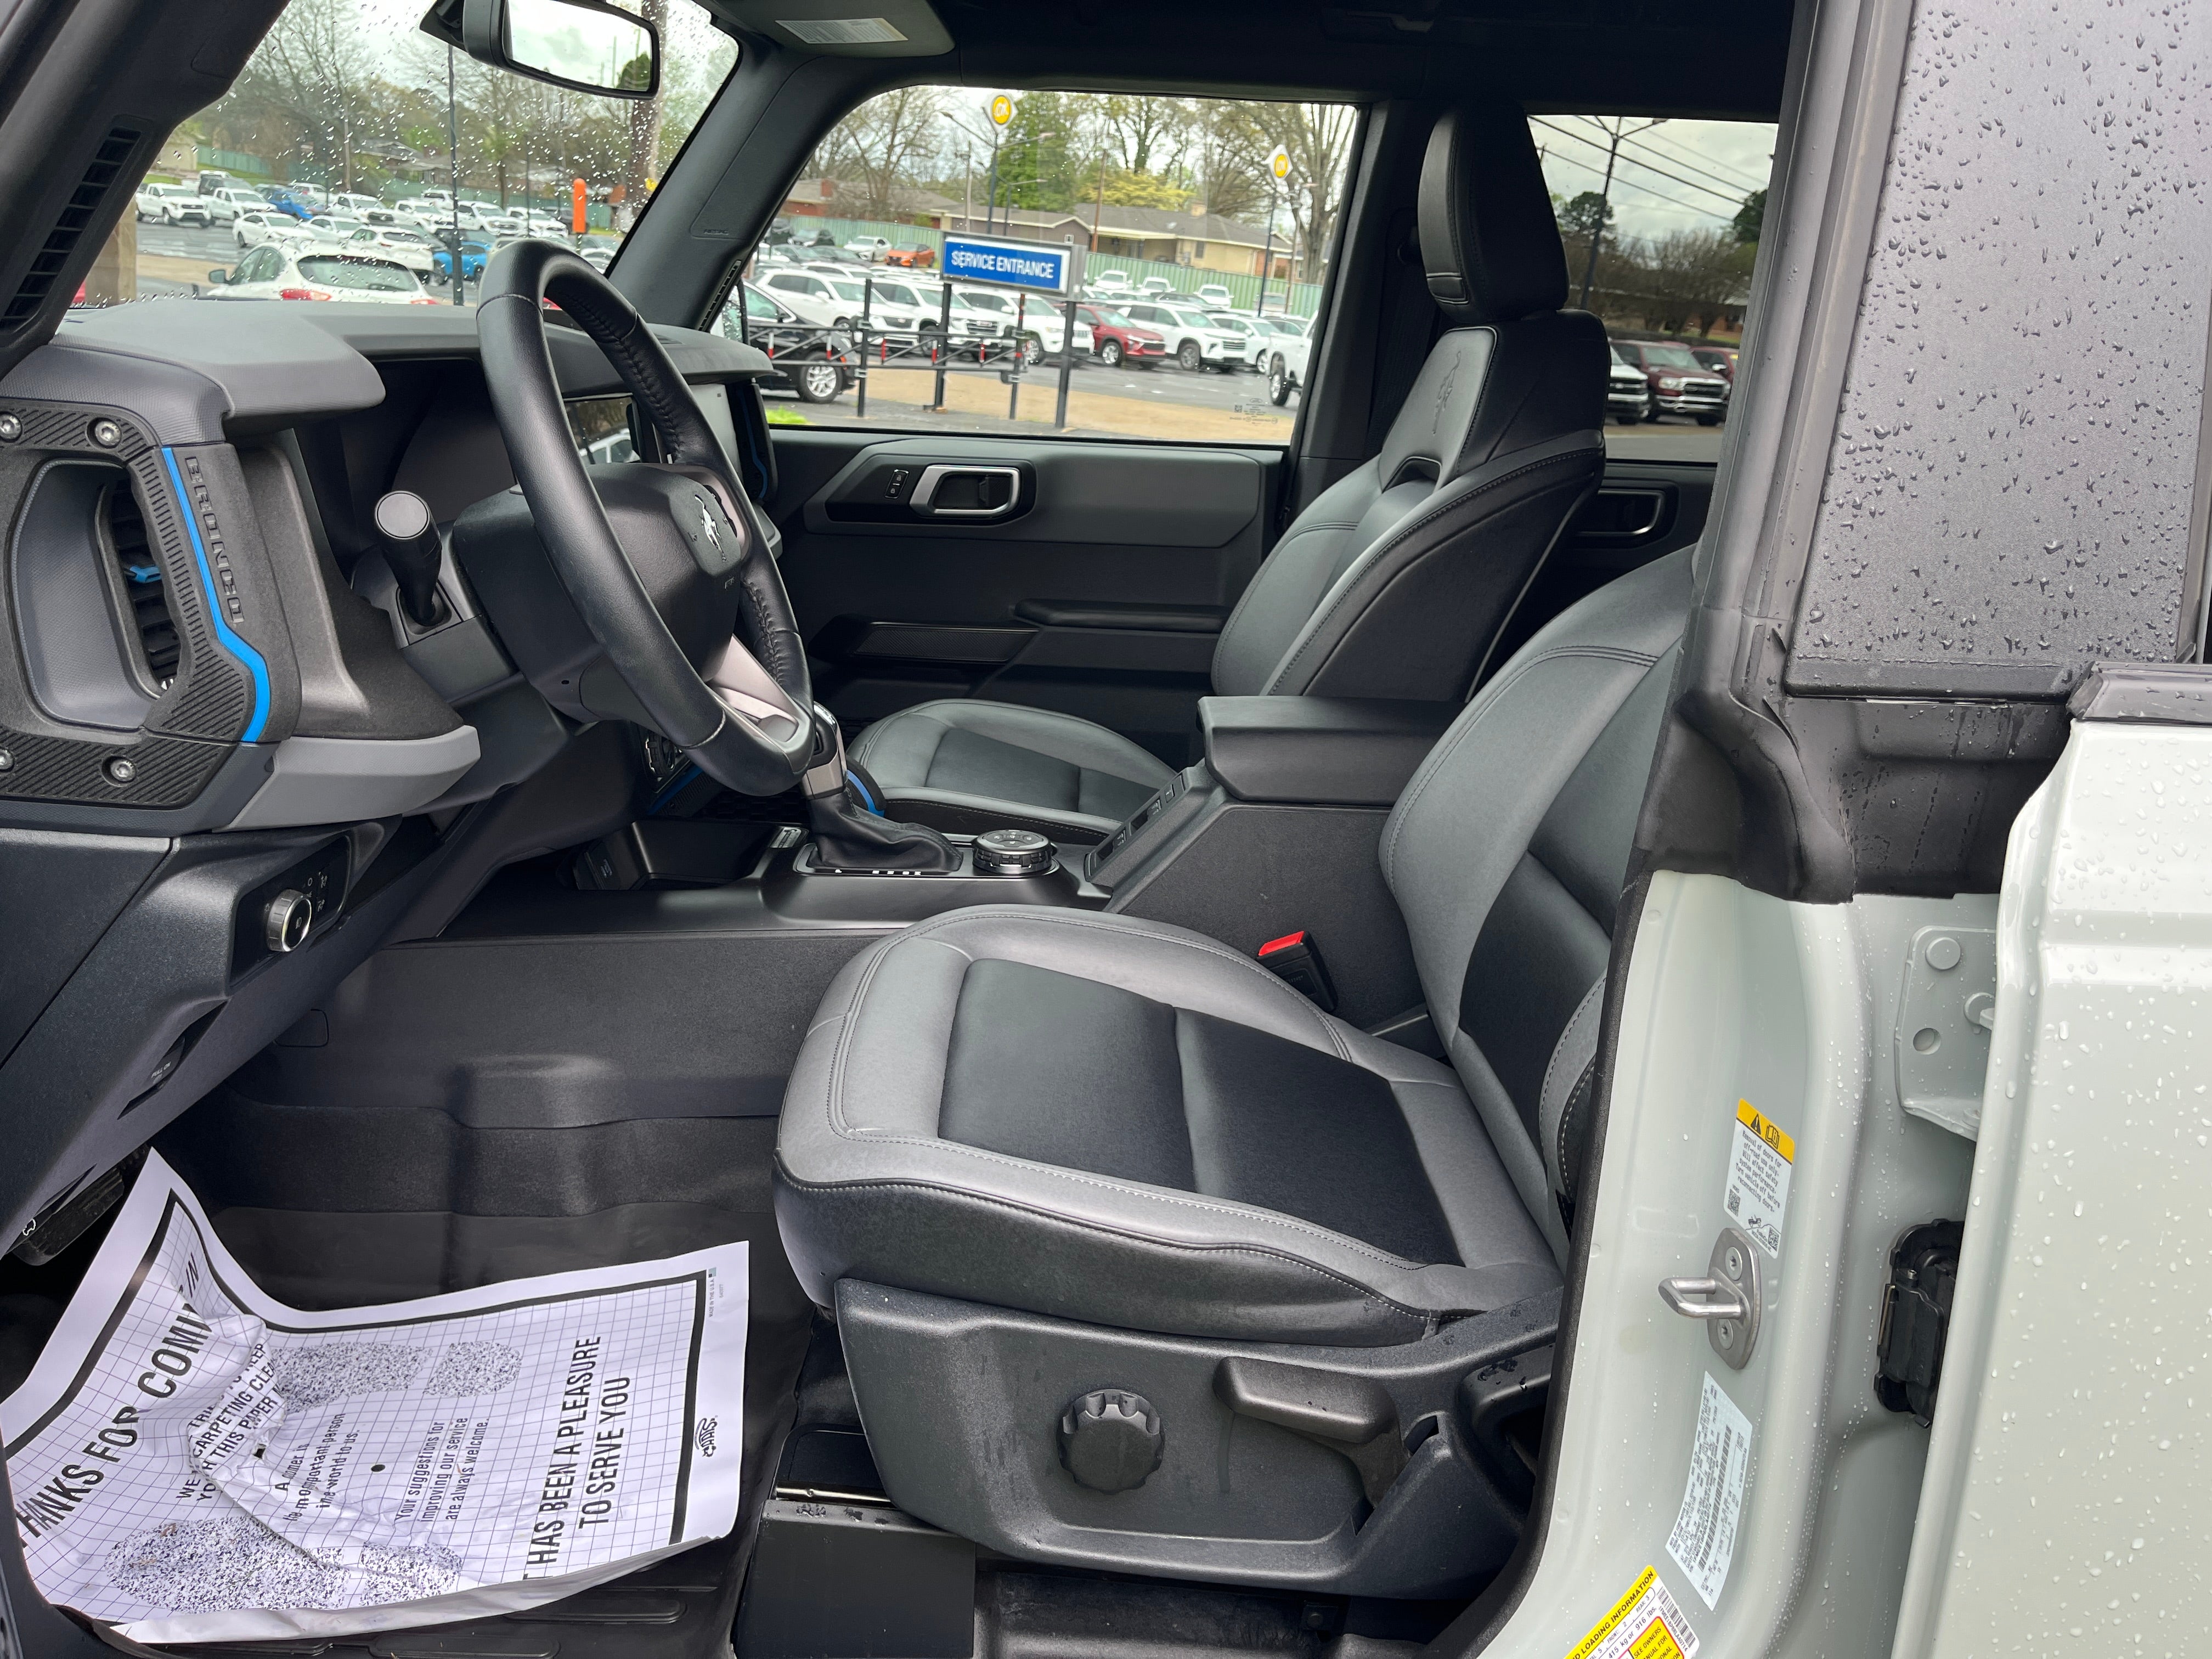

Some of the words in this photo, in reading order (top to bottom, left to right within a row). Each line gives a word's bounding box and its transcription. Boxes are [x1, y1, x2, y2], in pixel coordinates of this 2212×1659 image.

[951, 251, 995, 271] SERVICE
[996, 256, 1054, 279] ENTRANCE
[185, 456, 245, 623] BRONCO
[1742, 1130, 1756, 1148] Removal
[1757, 1141, 1762, 1152] of
[1763, 1147, 1774, 1163] doors
[1736, 1163, 1744, 1176] Turn
[1745, 1172, 1759, 1189] vehicle
[1742, 1150, 1751, 1162] Will
[1751, 1158, 1764, 1172] affect
[1765, 1170, 1779, 1187] safety
[250, 1356, 276, 1391] CLEA
[557, 1336, 601, 1438] PLEASURE
[599, 1376, 630, 1425] YOU
[193, 1391, 253, 1458] CARPETING
[213, 1431, 245, 1458] THIS
[239, 1396, 278, 1430] PAPER
[322, 1413, 346, 1442] person
[343, 1430, 360, 1443] us.
[447, 1418, 468, 1450] service
[464, 1418, 489, 1464] welcome.
[335, 1446, 352, 1455] to
[440, 1453, 455, 1470] our
[554, 1442, 583, 1455] A
[585, 1427, 624, 1493] SERVE
[18, 1464, 104, 1548] HANKS
[82, 1406, 140, 1463] FOR
[275, 1482, 290, 1492] A
[292, 1443, 310, 1452] is
[326, 1457, 347, 1489] world
[394, 1499, 417, 1521] Your
[408, 1436, 439, 1496] suggestions
[427, 1421, 445, 1435] for
[450, 1467, 475, 1502] always
[176, 1478, 201, 1499] WE
[196, 1482, 217, 1502] YO
[417, 1474, 453, 1522] improving
[539, 1463, 578, 1513] BEEN
[445, 1504, 461, 1520] are
[578, 1499, 612, 1530] TO
[526, 1520, 566, 1564] HAS
[1581, 1622, 1611, 1655] LOADING
[1610, 1571, 1654, 1623] INFORMATION
[1609, 1647, 1620, 1659] 415
[1620, 1638, 1629, 1648] kg
[1628, 1631, 1635, 1640] or
[1635, 1617, 1647, 1631] 916
[1634, 1648, 1644, 1658] SEE
[1643, 1627, 1662, 1649] OWNERS
[1657, 1635, 1668, 1647] FOR
